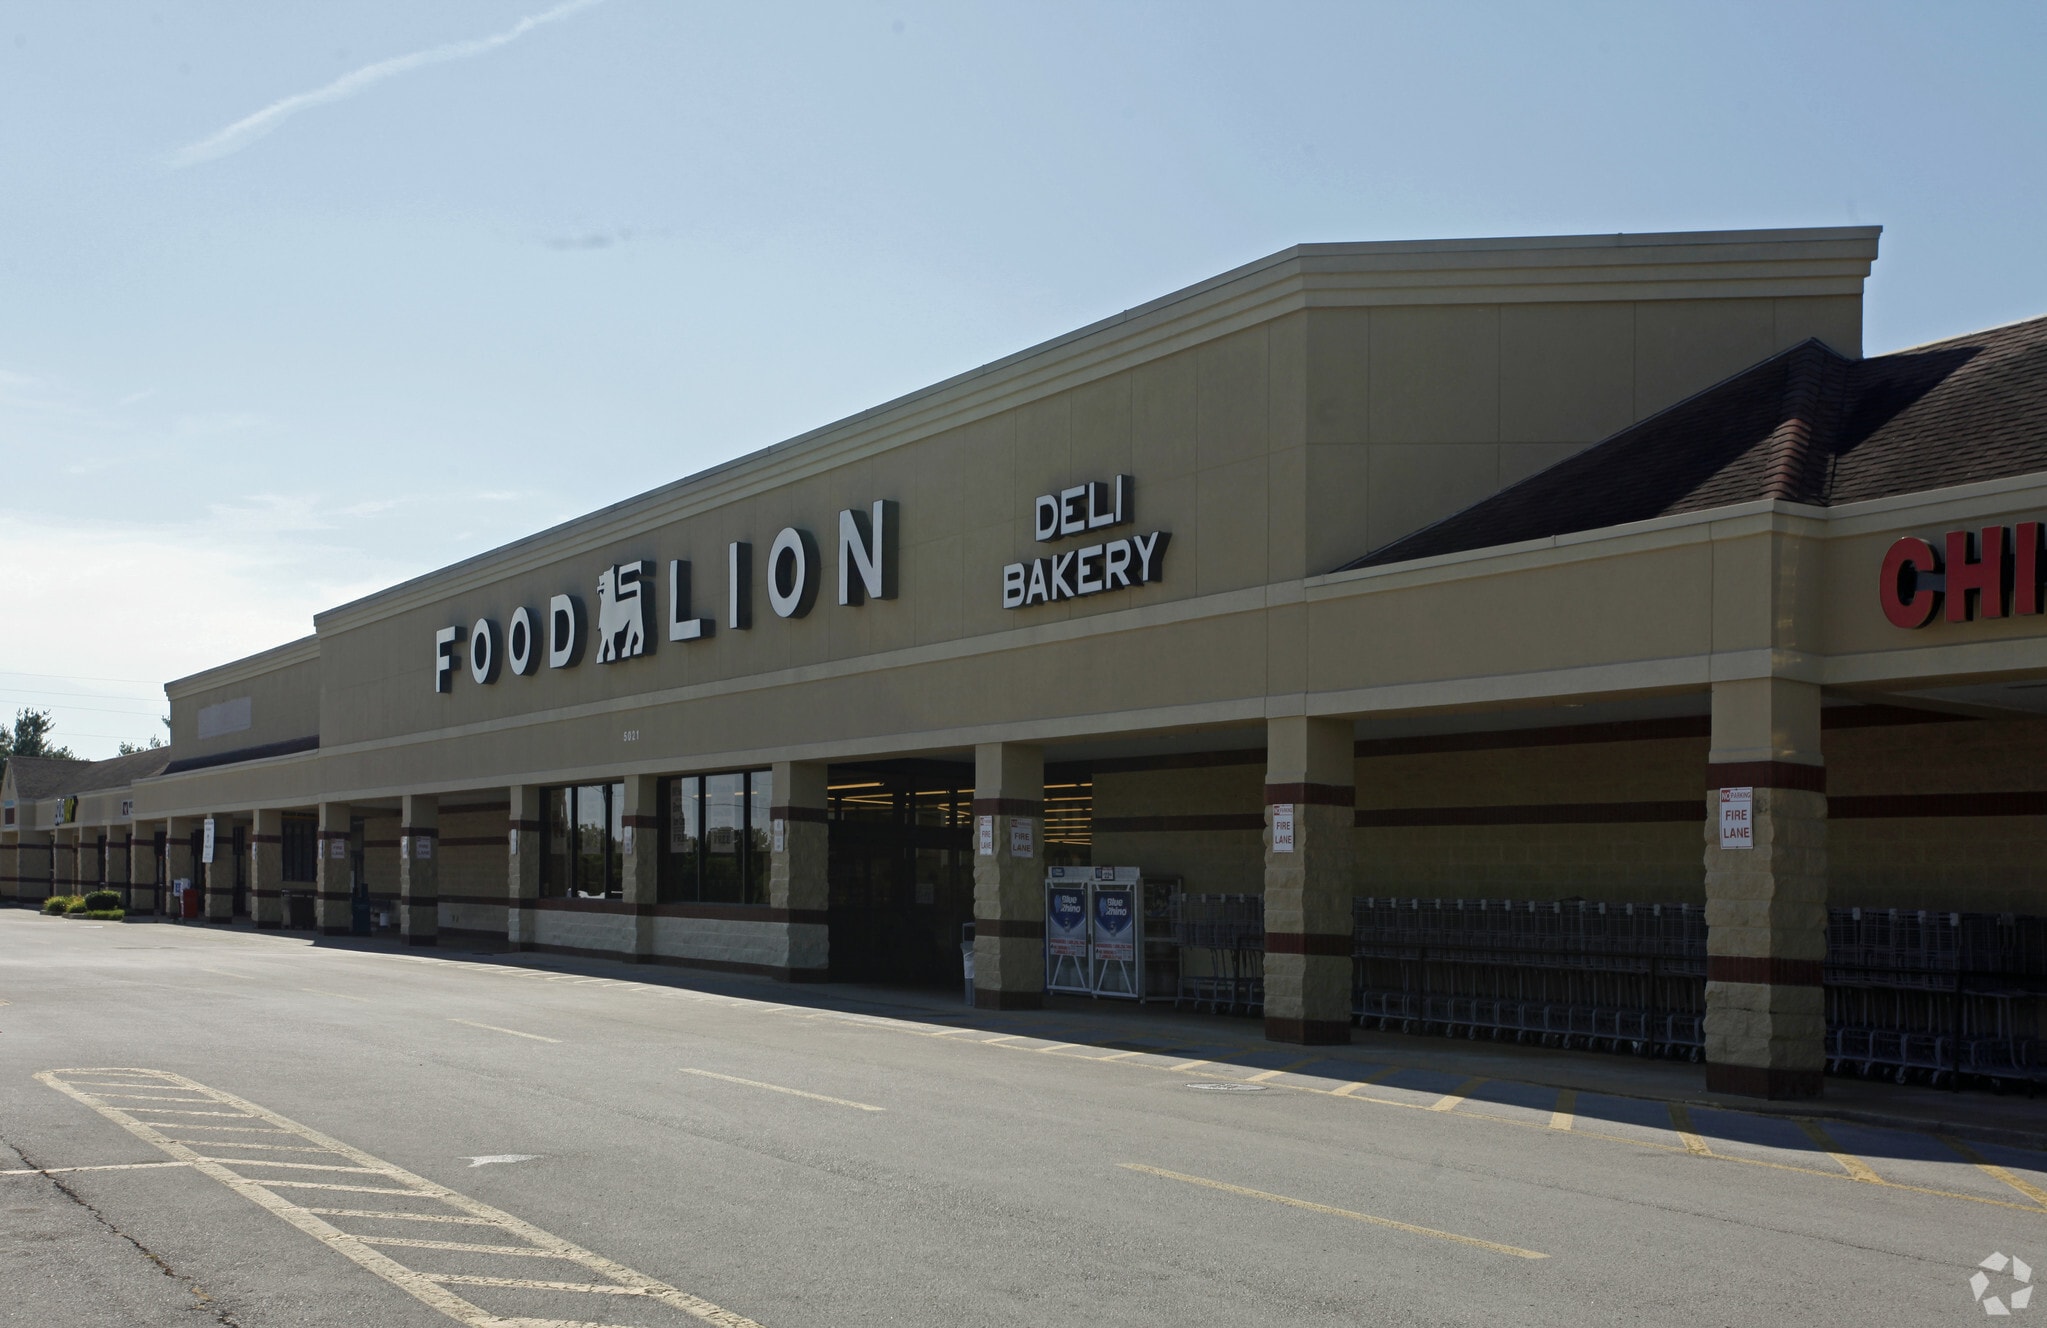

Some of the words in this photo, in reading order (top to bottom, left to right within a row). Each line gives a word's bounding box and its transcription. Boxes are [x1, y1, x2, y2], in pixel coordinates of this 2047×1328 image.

[1035, 474, 1126, 542] DELI
[1003, 530, 1164, 609] BAKERY
[435, 592, 578, 694] FOOD
[669, 499, 887, 642] LION
[623, 729, 640, 742] 5021
[1721, 791, 1731, 801] NO
[1731, 791, 1751, 799] PARKING
[1725, 809, 1748, 821] FIRE
[1276, 821, 1291, 830] FIRE
[1014, 832, 1030, 841] FIRE
[1723, 827, 1750, 839] LANE
[1275, 835, 1293, 844] LANE
[1013, 844, 1031, 852] LANE
[1062, 895, 1078, 904] Blue
[1107, 897, 1124, 907] Blue
